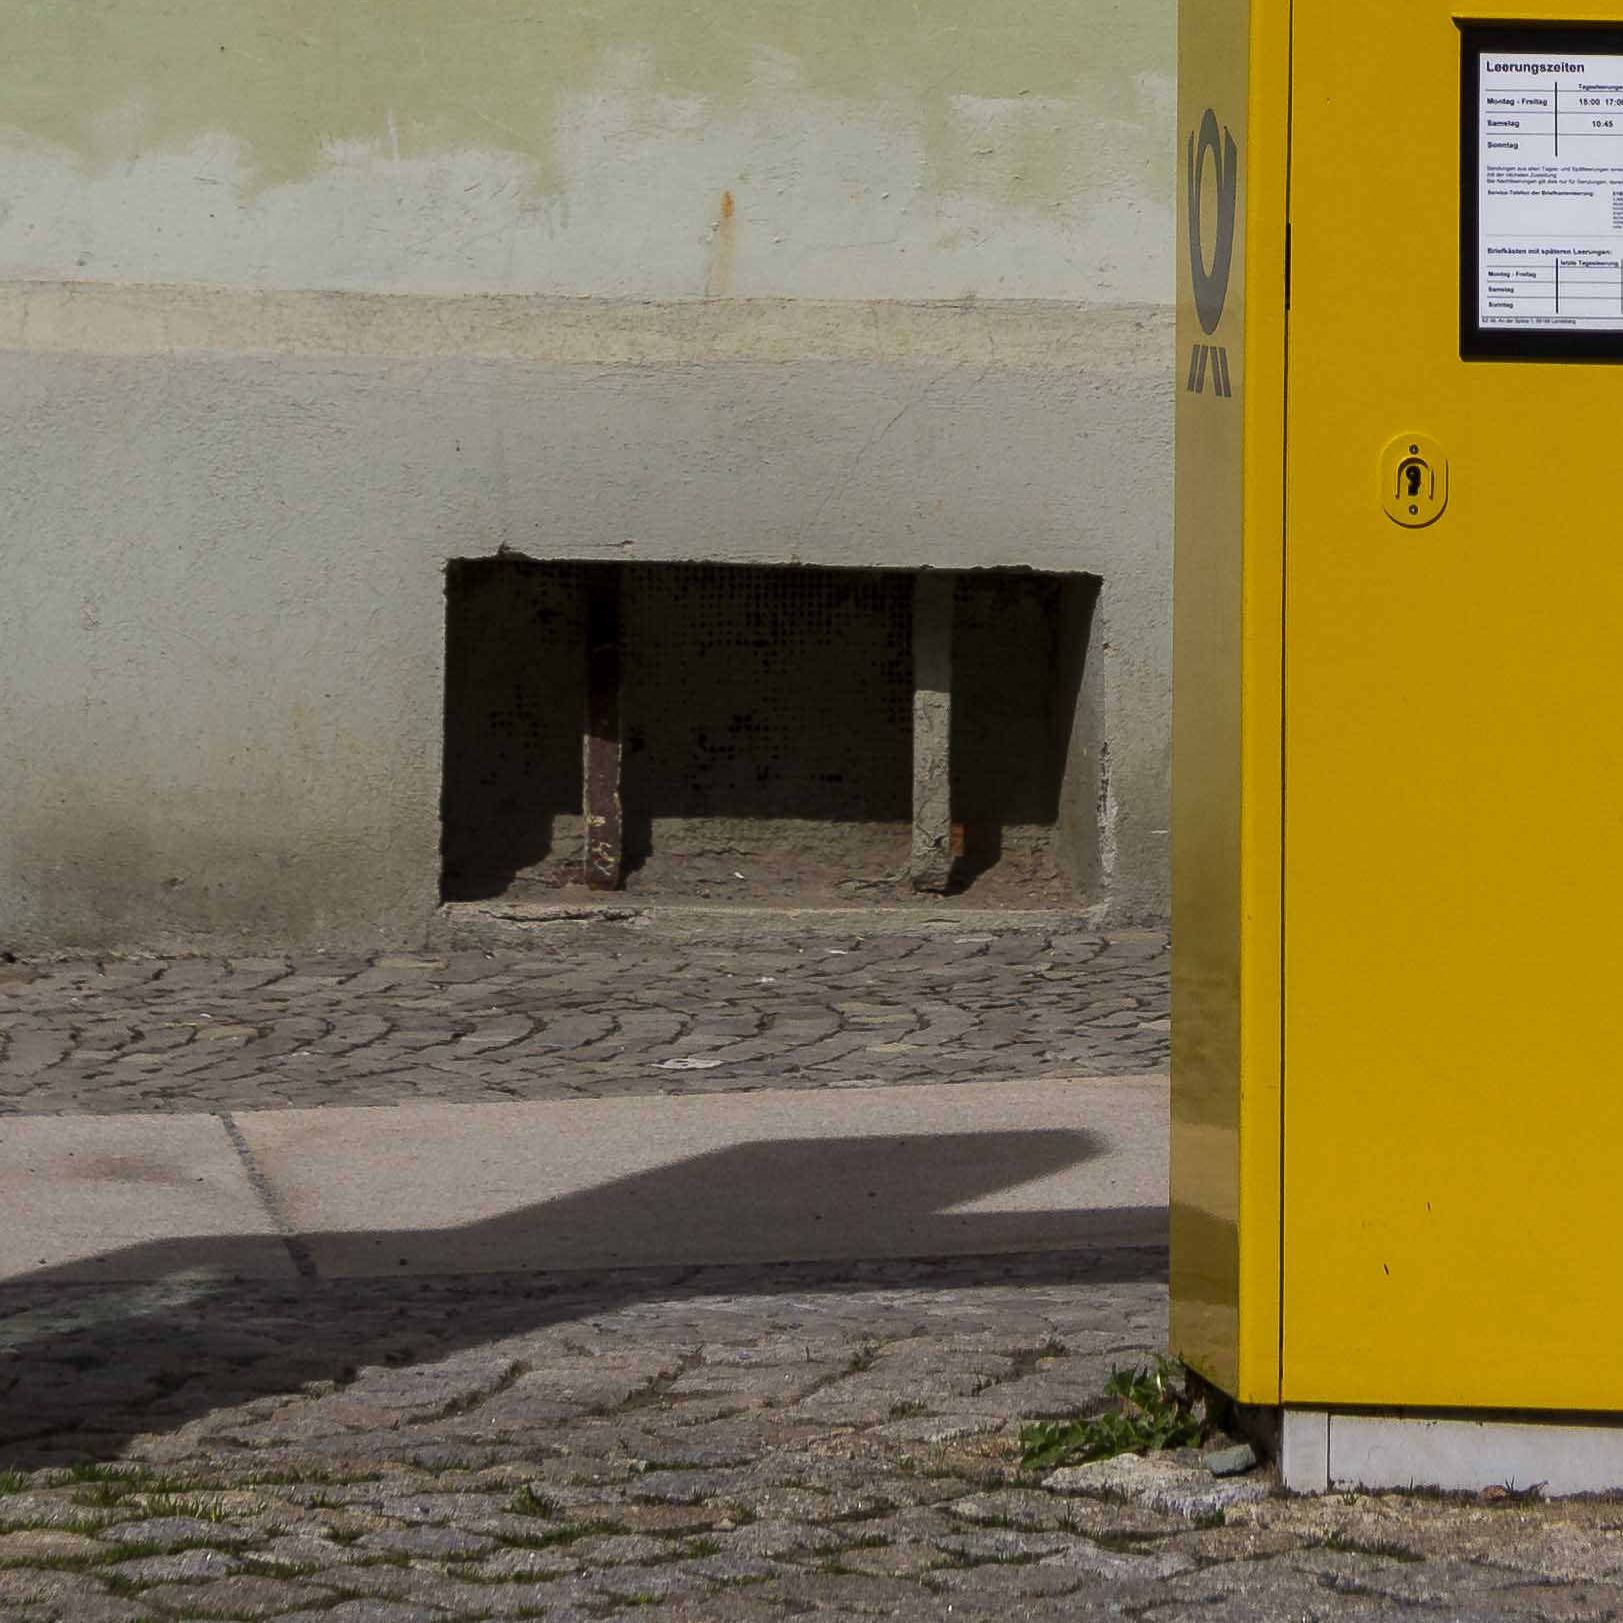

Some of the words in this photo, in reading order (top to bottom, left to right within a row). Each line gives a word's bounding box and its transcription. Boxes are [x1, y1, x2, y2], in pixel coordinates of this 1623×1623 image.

[1486, 61, 1585, 75] Leerungszeiten
[1486, 97, 1515, 107] Montag
[1521, 97, 1548, 107] Freitag
[1487, 119, 1520, 128] Samstag
[1591, 120, 1614, 128] 10:45
[1487, 141, 1519, 150] Sonntag
[1528, 247, 1540, 255] mit
